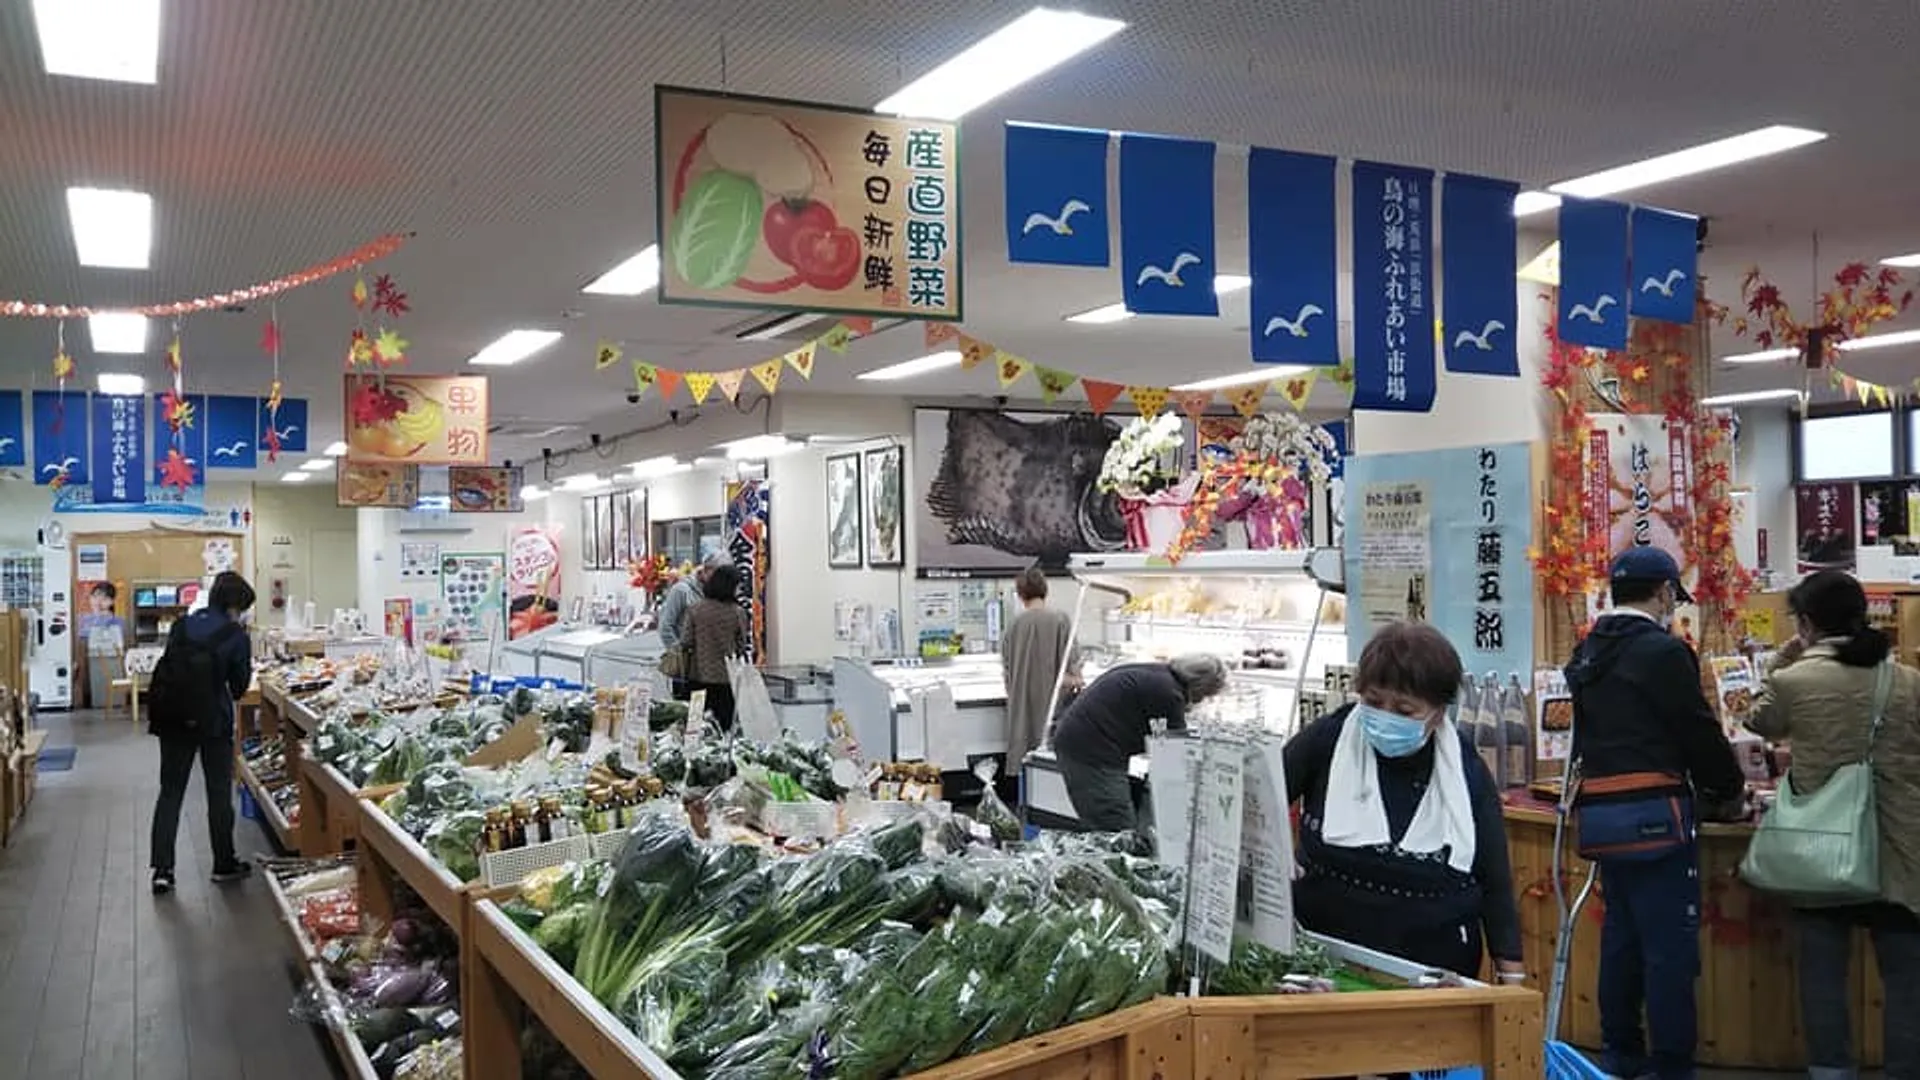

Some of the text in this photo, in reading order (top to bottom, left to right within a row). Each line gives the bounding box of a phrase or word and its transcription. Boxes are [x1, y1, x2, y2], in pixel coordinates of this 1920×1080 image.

[862, 130, 894, 291] 毎日新鮮
[905, 128, 947, 307] 産直野菜
[1383, 176, 1407, 402] 鳥の海ふれあい市場
[447, 385, 480, 456] 果物
